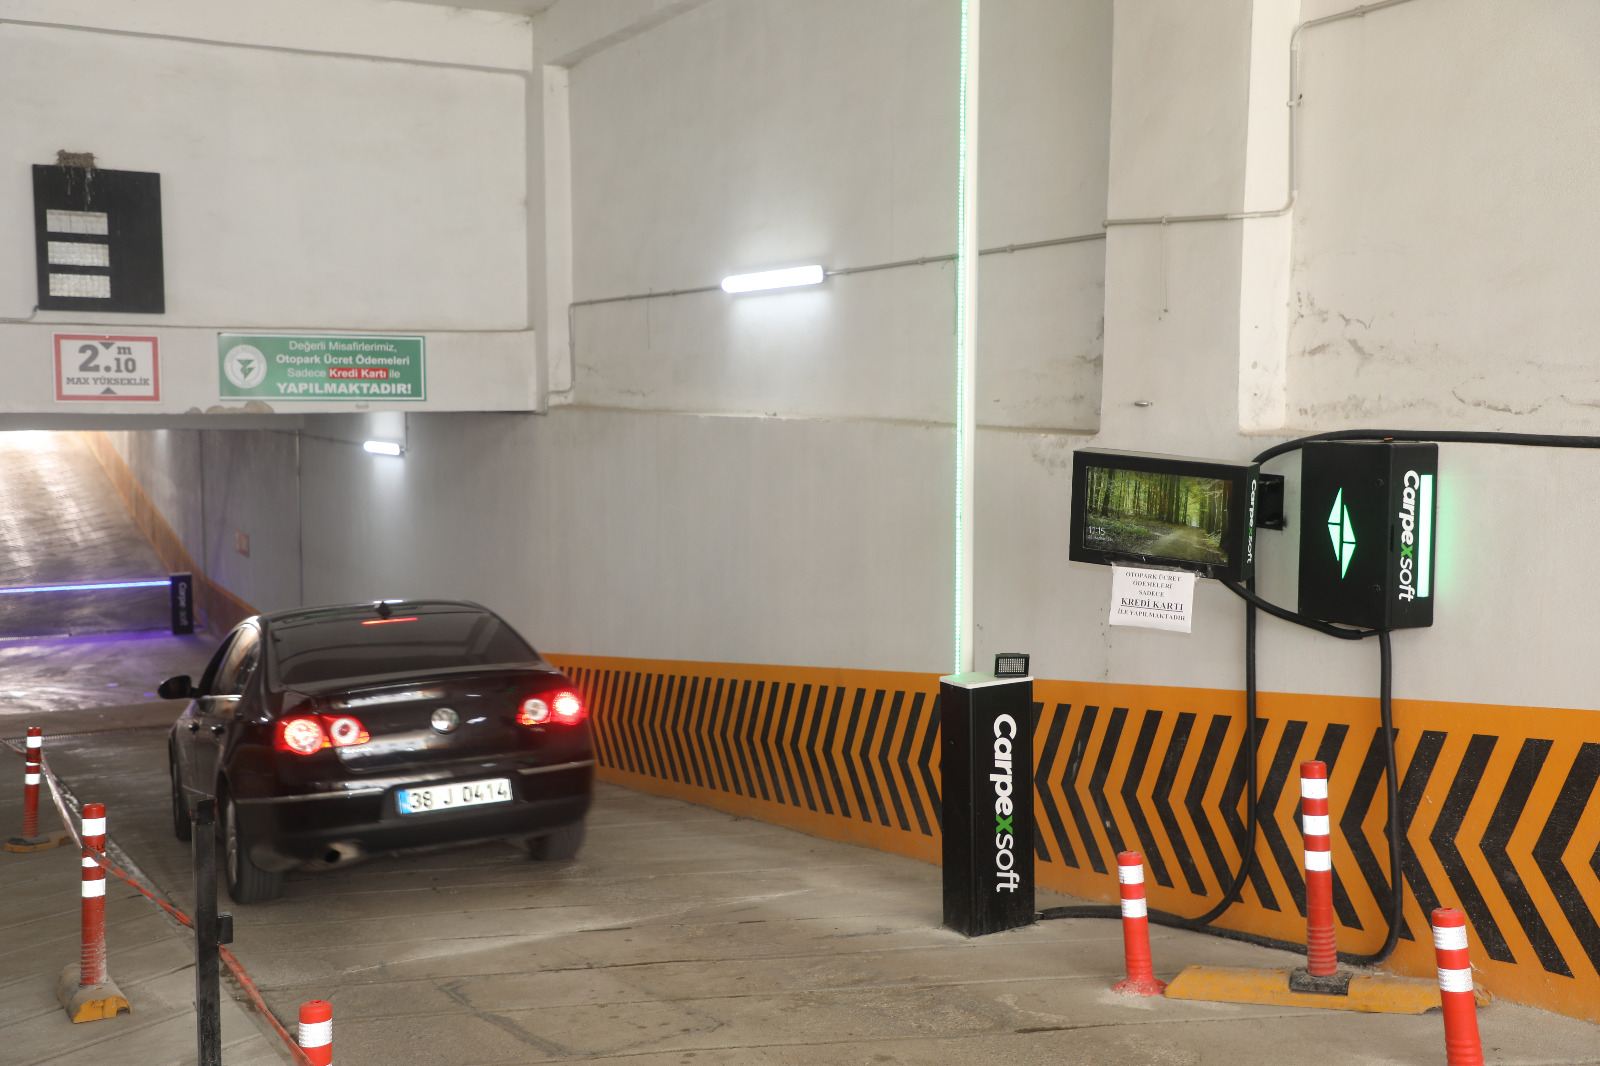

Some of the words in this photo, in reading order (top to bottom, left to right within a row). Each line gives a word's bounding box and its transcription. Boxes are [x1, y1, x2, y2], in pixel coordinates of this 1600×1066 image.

[289, 341, 326, 352] Değerli
[329, 341, 397, 353] Misafirlerimiz,
[276, 354, 320, 365] Otopark
[324, 353, 353, 364] Ücret
[356, 354, 410, 365] Ödemeleri
[287, 368, 326, 378] Sadece
[329, 368, 358, 378] Kredi
[361, 369, 386, 378] Kartı
[389, 369, 400, 378] ile
[66, 377, 90, 385] MAX
[92, 376, 150, 386] YÜKSEKLİK
[276, 382, 412, 394] YAPILMAKTADIR!
[1398, 469, 1420, 602] Carpexsoft
[1126, 571, 1157, 580] OTOPARK
[1159, 573, 1181, 582] ÜCRET
[1133, 579, 1172, 589] ÖDEMELERİ
[1121, 598, 1150, 607] KREDİ
[1153, 601, 1183, 611] KARTI
[1130, 610, 1185, 621] YAPILMAKTADIR
[411, 791, 433, 810] 38
[443, 788, 453, 805] J
[462, 782, 508, 803] 0414
[989, 713, 1020, 893] Carpexsoft
